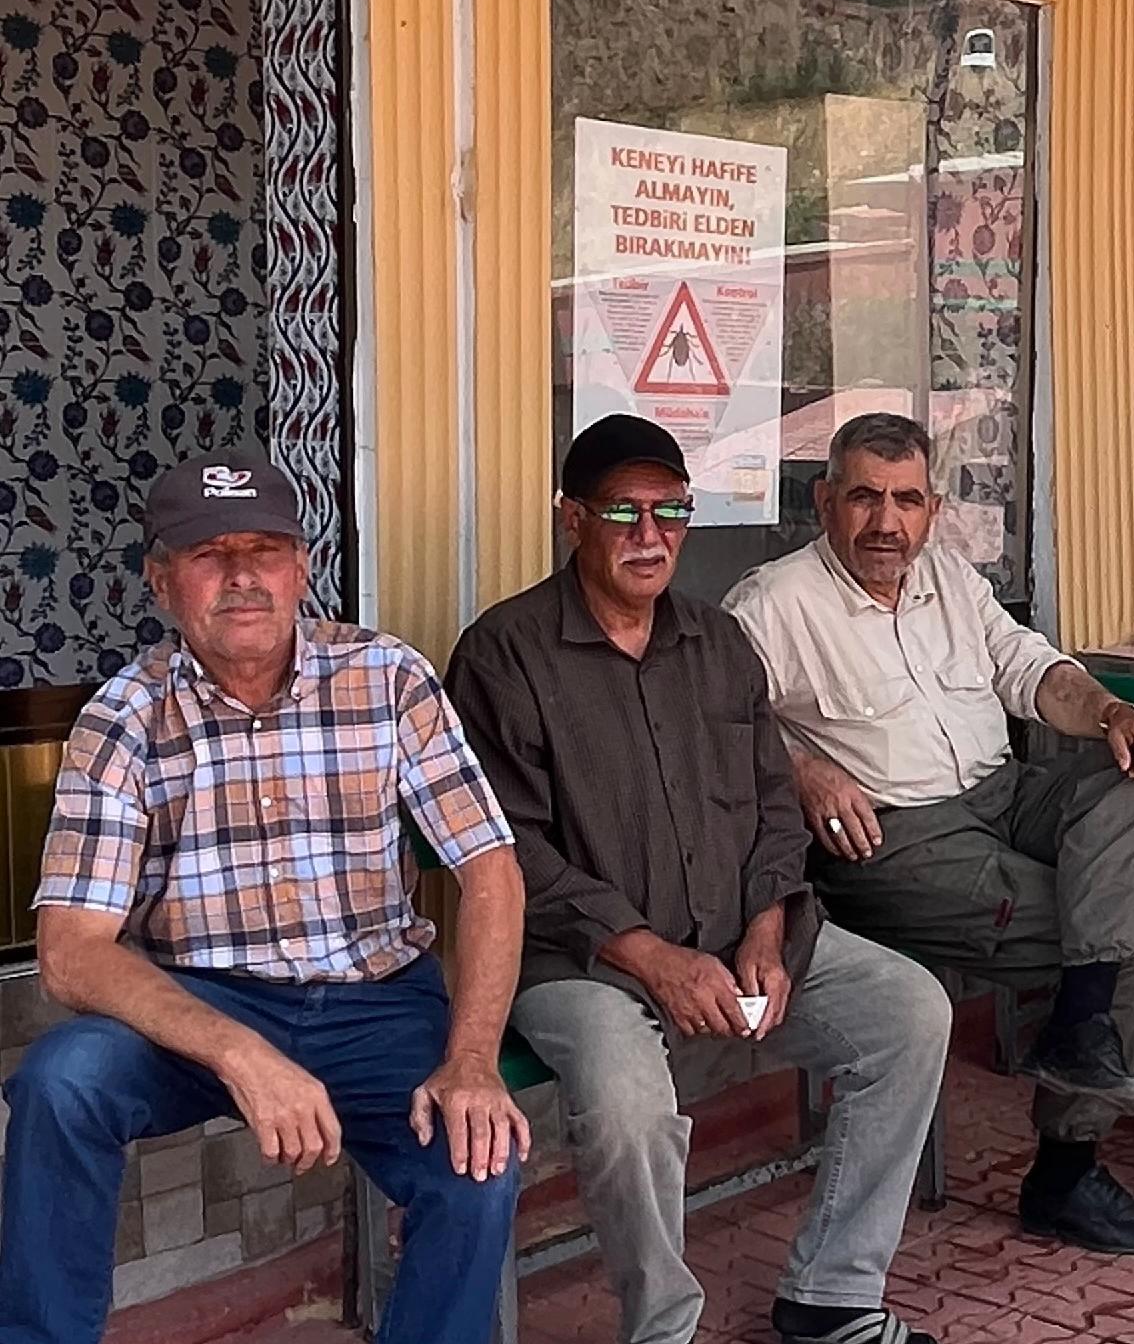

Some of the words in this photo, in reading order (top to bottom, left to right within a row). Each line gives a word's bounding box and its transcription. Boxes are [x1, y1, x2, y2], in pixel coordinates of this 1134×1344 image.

[635, 179, 735, 212] ALMAYIN,
[694, 214, 755, 238] ELDEN
[615, 234, 752, 265] BIRAKMAYIN!
